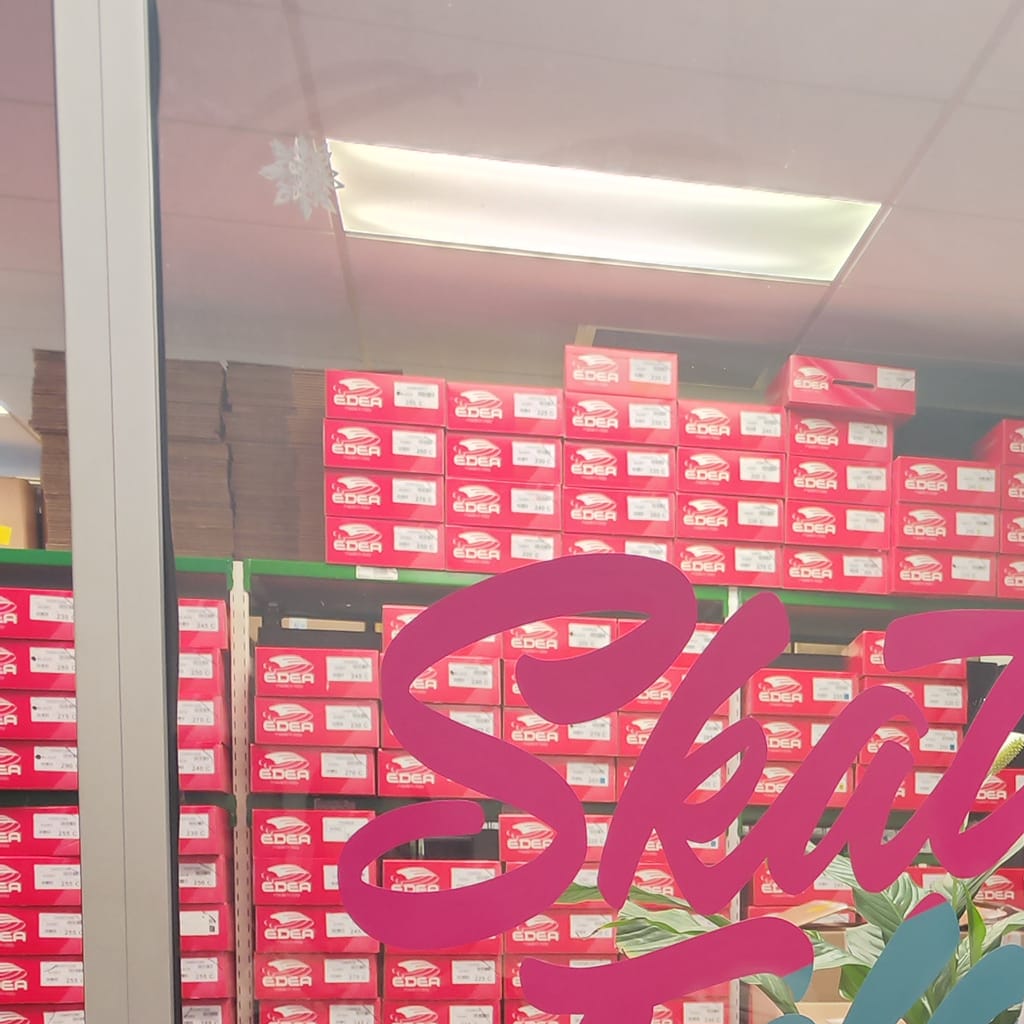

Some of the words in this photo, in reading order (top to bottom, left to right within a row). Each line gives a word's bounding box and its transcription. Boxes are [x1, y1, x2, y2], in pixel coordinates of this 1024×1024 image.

[573, 370, 619, 383] EDEA
[793, 379, 829, 391] EDEA
[334, 394, 383, 408] EDEA
[456, 407, 503, 419] EDEA
[573, 416, 619, 429] EDEA
[686, 424, 731, 436] EDEA
[796, 434, 839, 446] EDEA
[332, 443, 381, 457] EDEA
[454, 455, 501, 468] EDEA
[572, 464, 617, 477] EDEA
[685, 470, 730, 482] EDEA
[794, 478, 837, 490] EDEA
[905, 480, 948, 492] EDEA
[332, 493, 381, 506] EDEA
[453, 502, 500, 515] EDEA
[571, 509, 617, 522] EDEA
[684, 516, 728, 527] EDEA
[793, 523, 836, 535] EDEA
[904, 525, 946, 537] EDEA
[334, 540, 382, 553] EDEA
[454, 548, 500, 561] EDEA
[681, 561, 725, 573] EDEA
[790, 568, 833, 579] EDEA
[900, 571, 943, 582] EDEA
[511, 638, 558, 650] EDEA
[264, 672, 315, 684] EDEA
[637, 689, 672, 700] DEA
[759, 692, 803, 704] EDEA
[264, 721, 314, 733] EDEA
[512, 731, 559, 743] EDEA
[768, 738, 802, 749] DEA
[260, 769, 310, 781] EDEA
[387, 773, 435, 785] EDEA
[755, 783, 785, 793] EDE
[976, 790, 1007, 800] DEA
[261, 833, 311, 846] EDEA
[262, 881, 311, 893] EDEA
[265, 929, 314, 940] EDEA
[513, 930, 559, 942] EDEA
[263, 975, 312, 988] EDEA
[393, 975, 441, 988] EDEA
